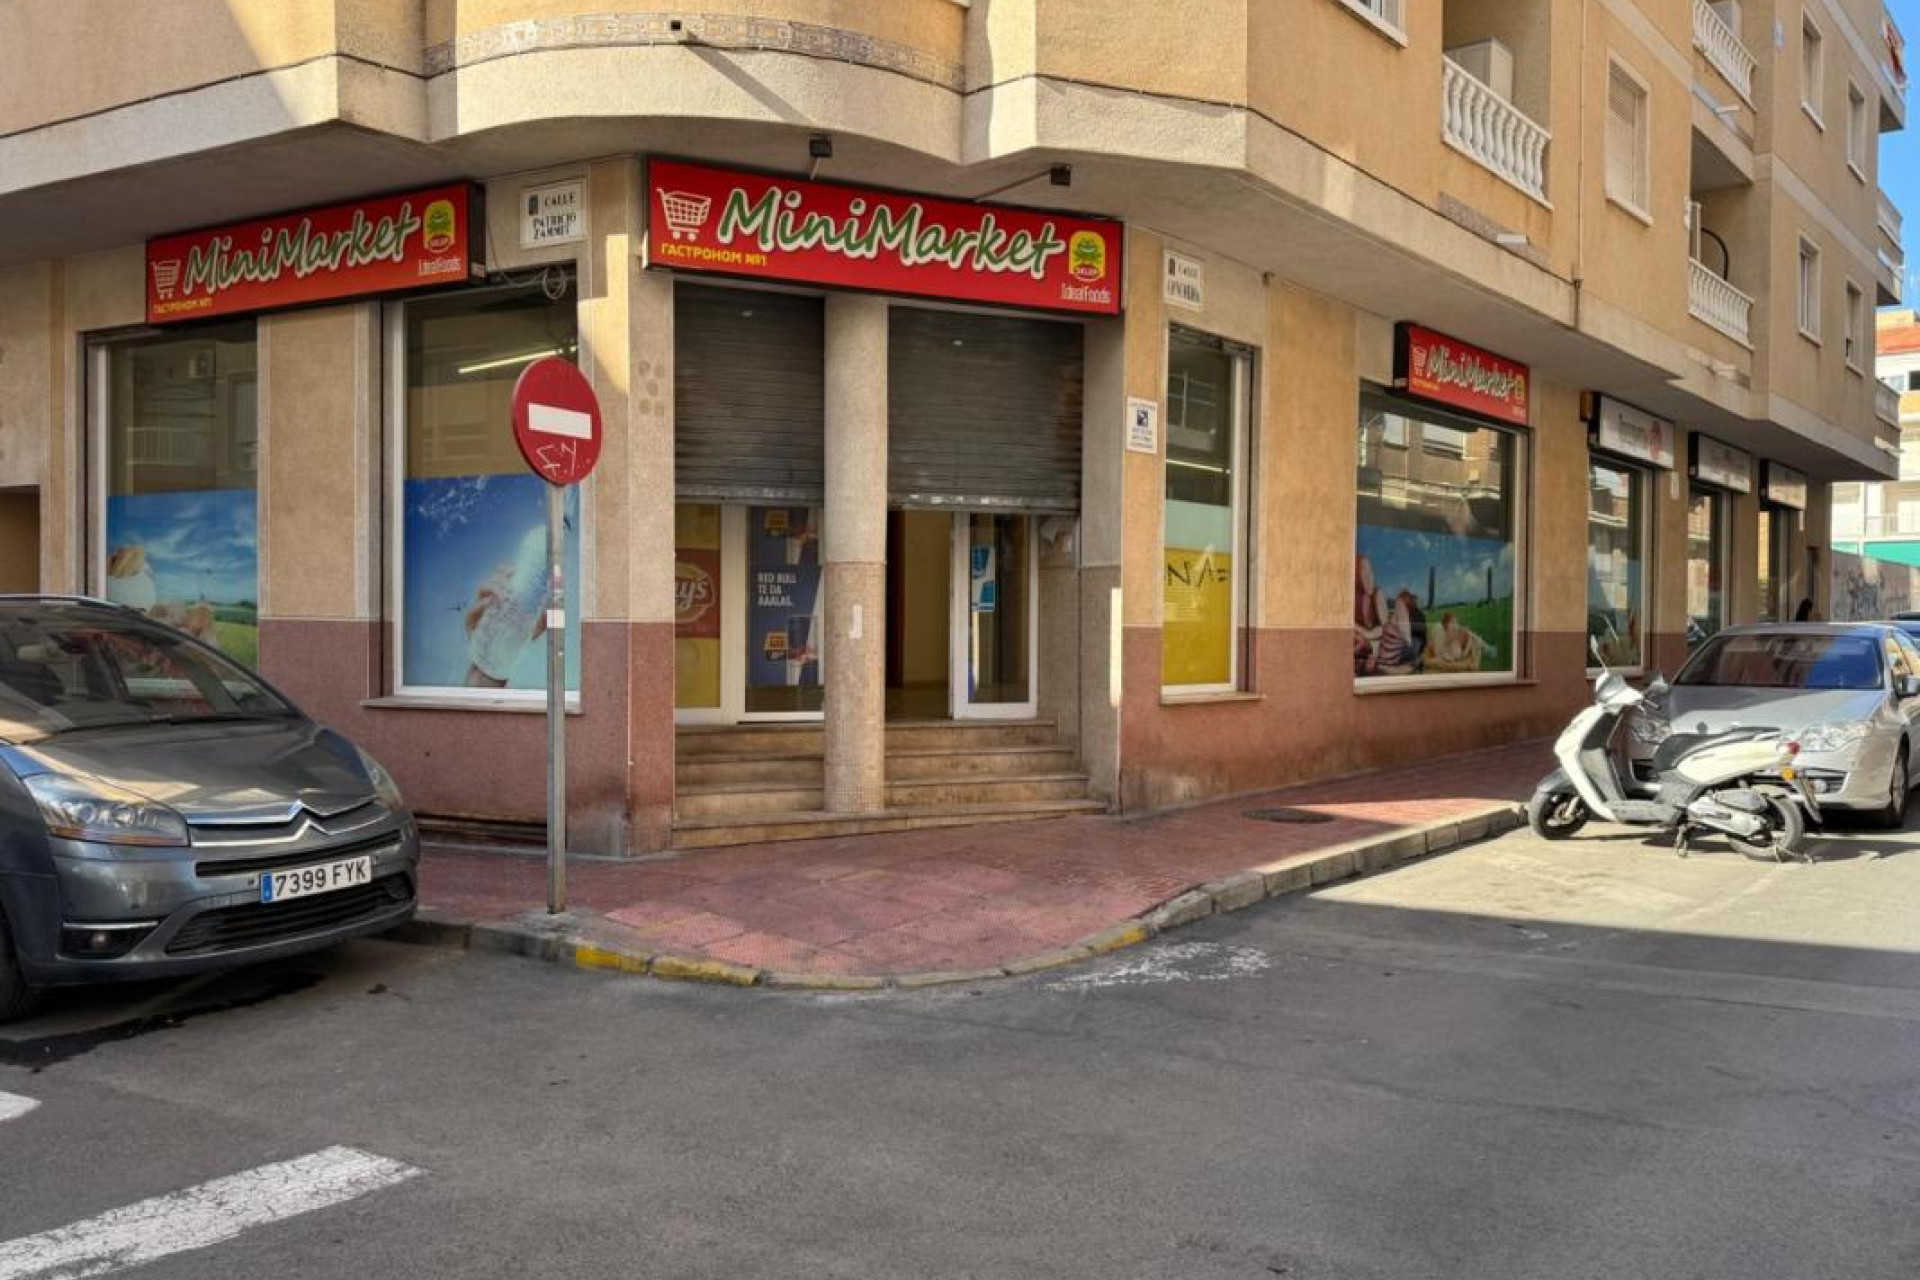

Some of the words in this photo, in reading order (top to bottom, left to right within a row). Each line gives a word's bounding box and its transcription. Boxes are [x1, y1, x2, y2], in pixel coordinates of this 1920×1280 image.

[544, 192, 576, 208] CALLE
[183, 201, 421, 296] MiniMarket
[662, 242, 742, 264] ГАСТРОНОМ
[717, 186, 1066, 279] MiniMarket
[1426, 343, 1517, 403] MiniMarket
[274, 868, 327, 897] 7399
[332, 861, 366, 886] FYK
